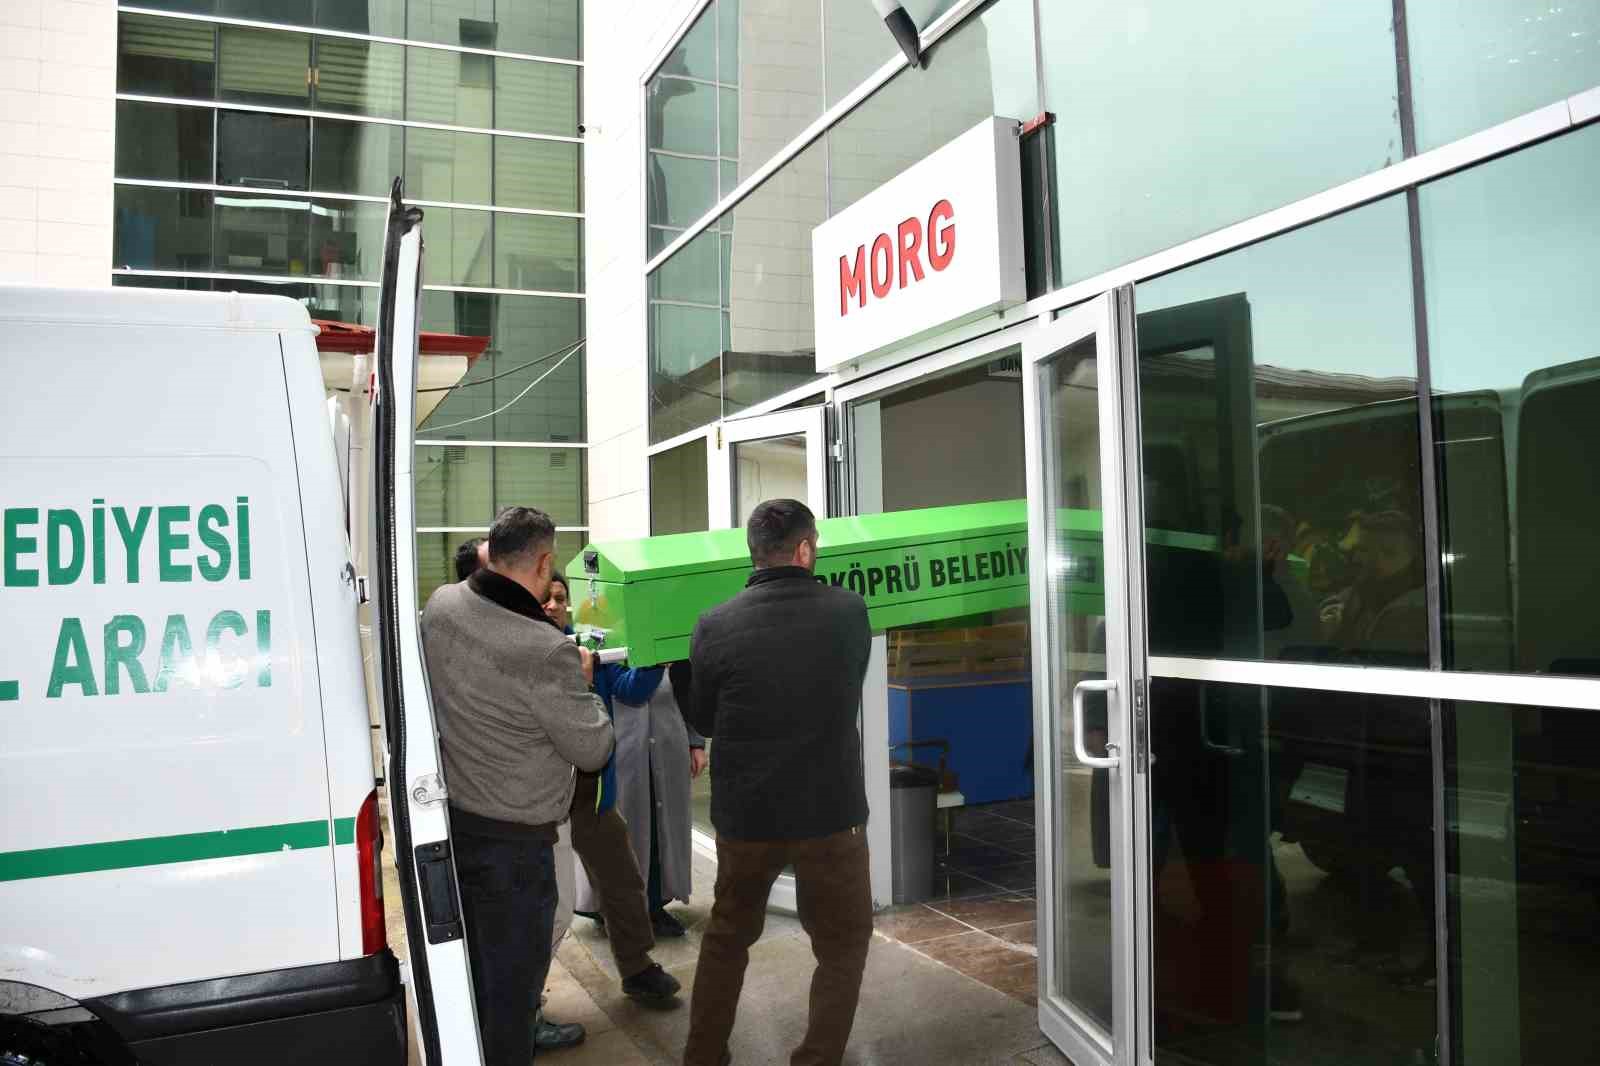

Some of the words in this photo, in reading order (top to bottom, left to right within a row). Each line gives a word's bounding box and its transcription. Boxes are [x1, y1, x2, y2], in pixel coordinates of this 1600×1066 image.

[839, 199, 955, 317] MORG
[4, 496, 251, 587] EDİYESİ
[46, 609, 272, 698] ARACI
